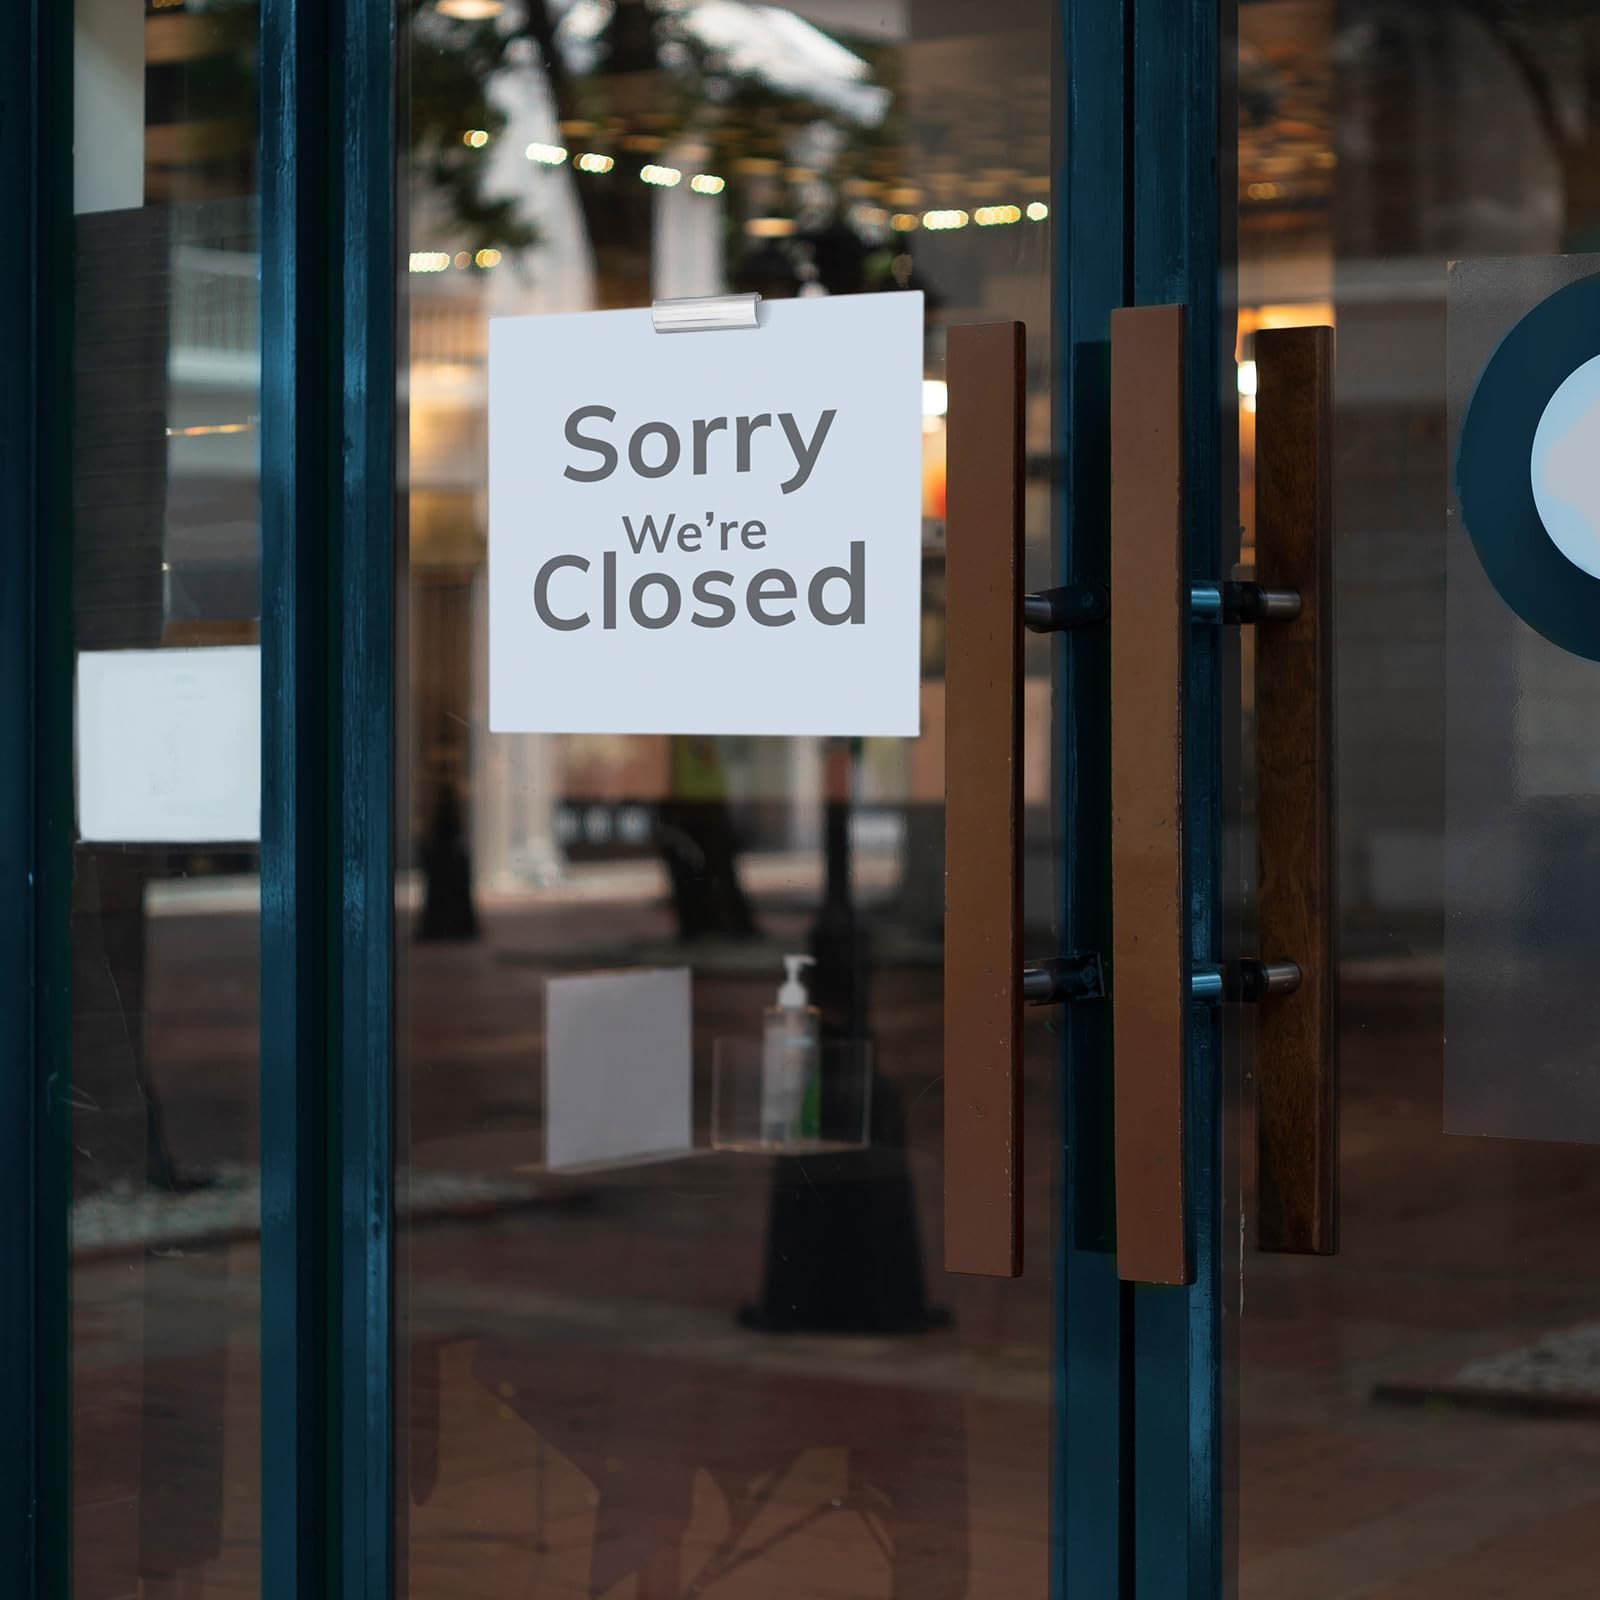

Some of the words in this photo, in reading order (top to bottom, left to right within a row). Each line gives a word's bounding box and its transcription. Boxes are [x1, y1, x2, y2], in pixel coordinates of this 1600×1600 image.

[563, 404, 838, 495] Sorry
[622, 511, 767, 556] We’re
[533, 540, 866, 632] Closed
